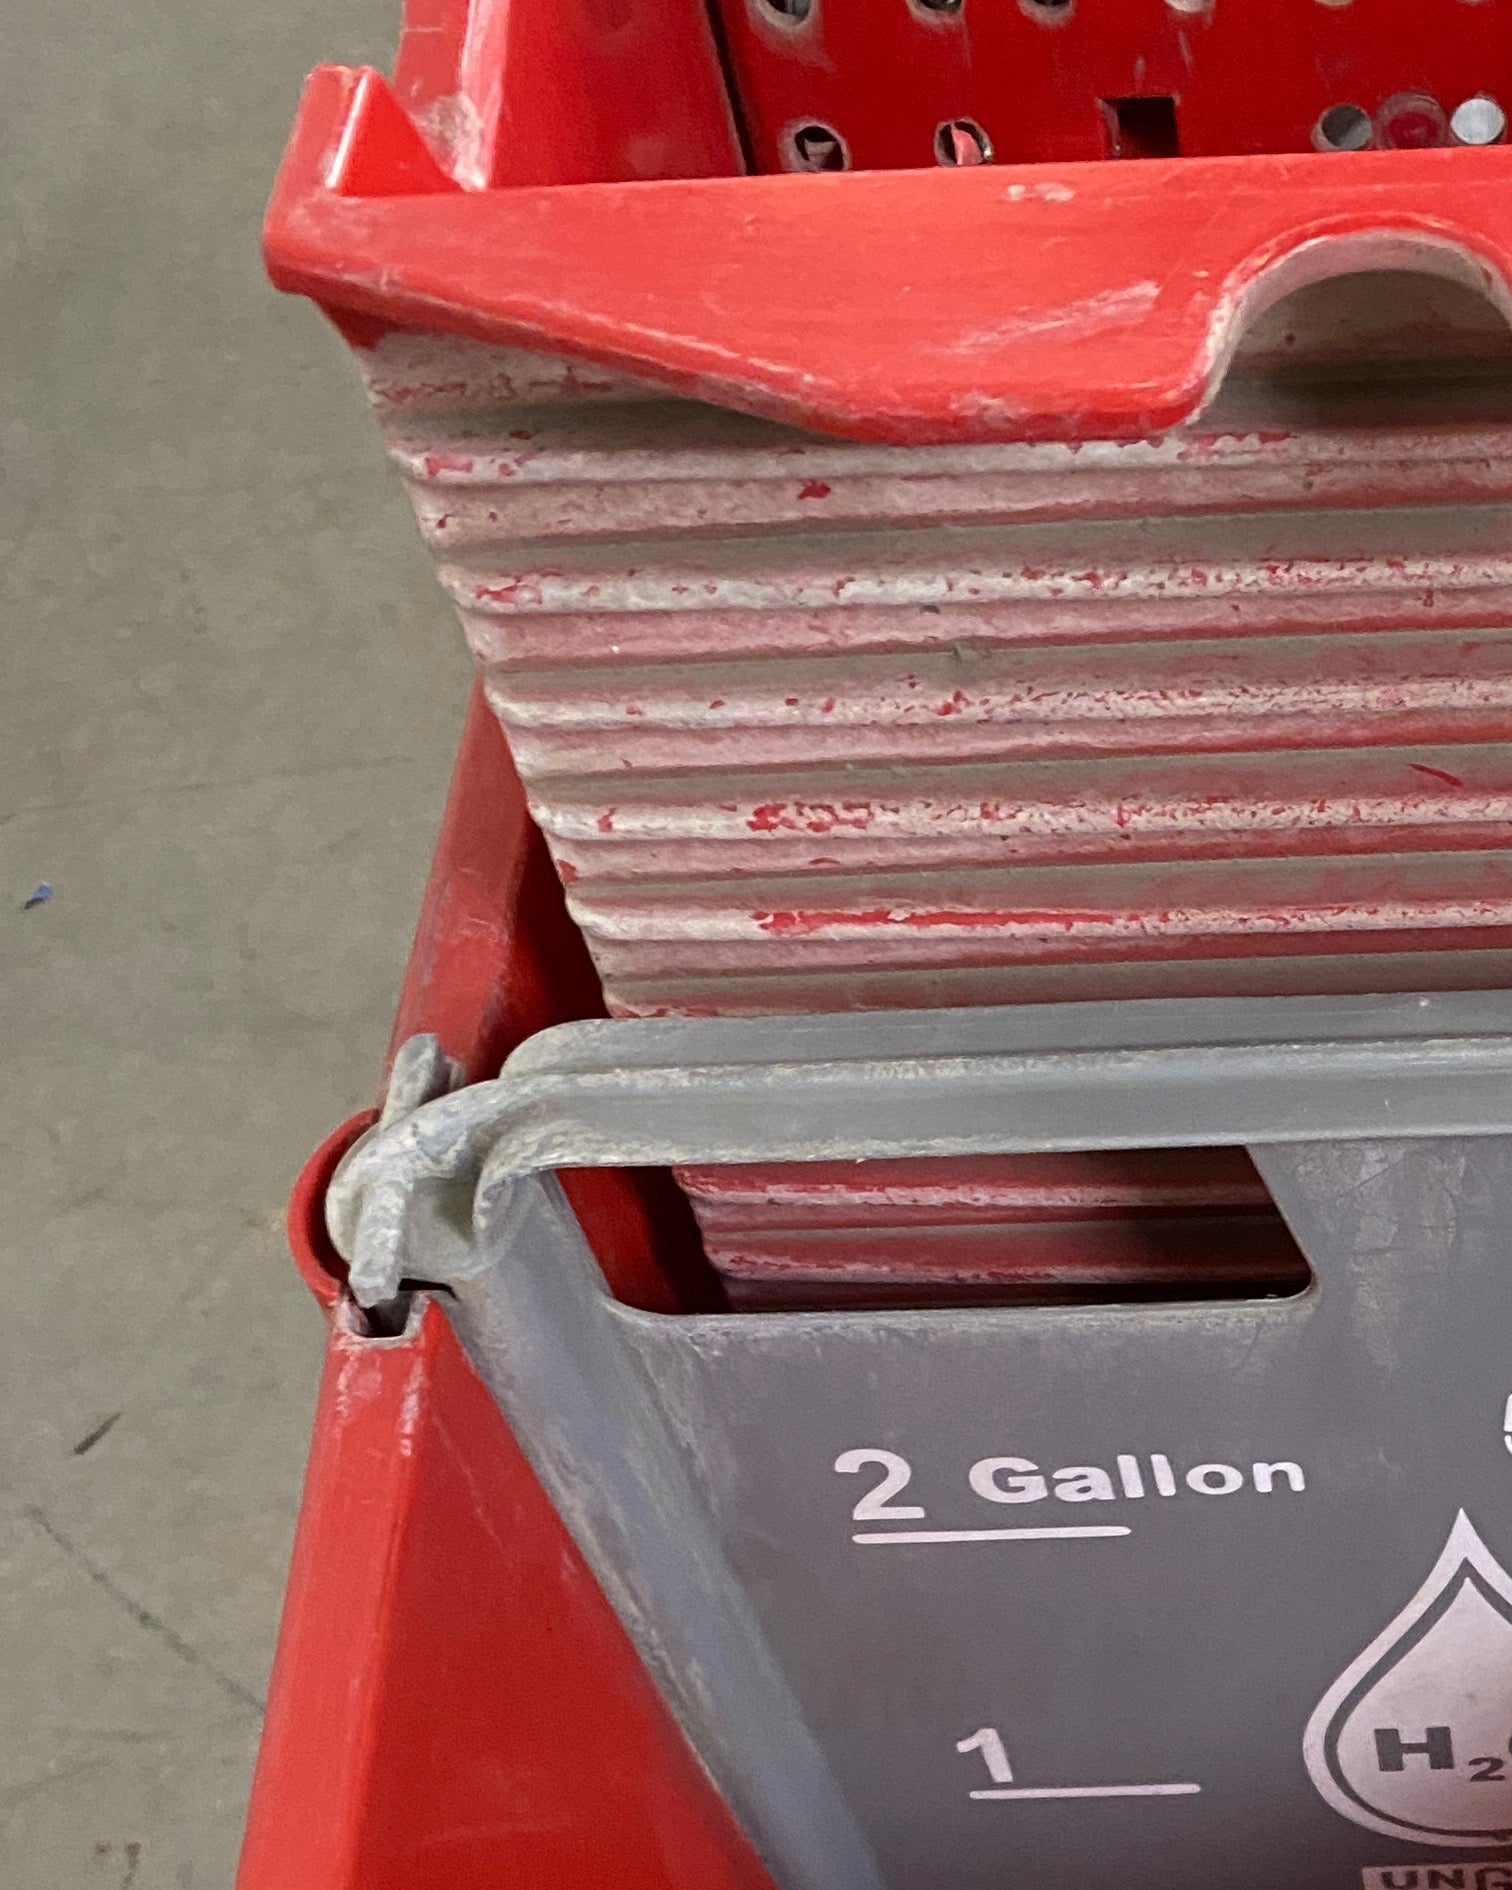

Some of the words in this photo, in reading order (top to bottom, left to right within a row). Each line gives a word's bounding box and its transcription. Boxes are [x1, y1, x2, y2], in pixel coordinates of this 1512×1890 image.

[834, 1449, 925, 1520] 2
[968, 1454, 1305, 1503] Gallon
[956, 1728, 1013, 1782] 1
